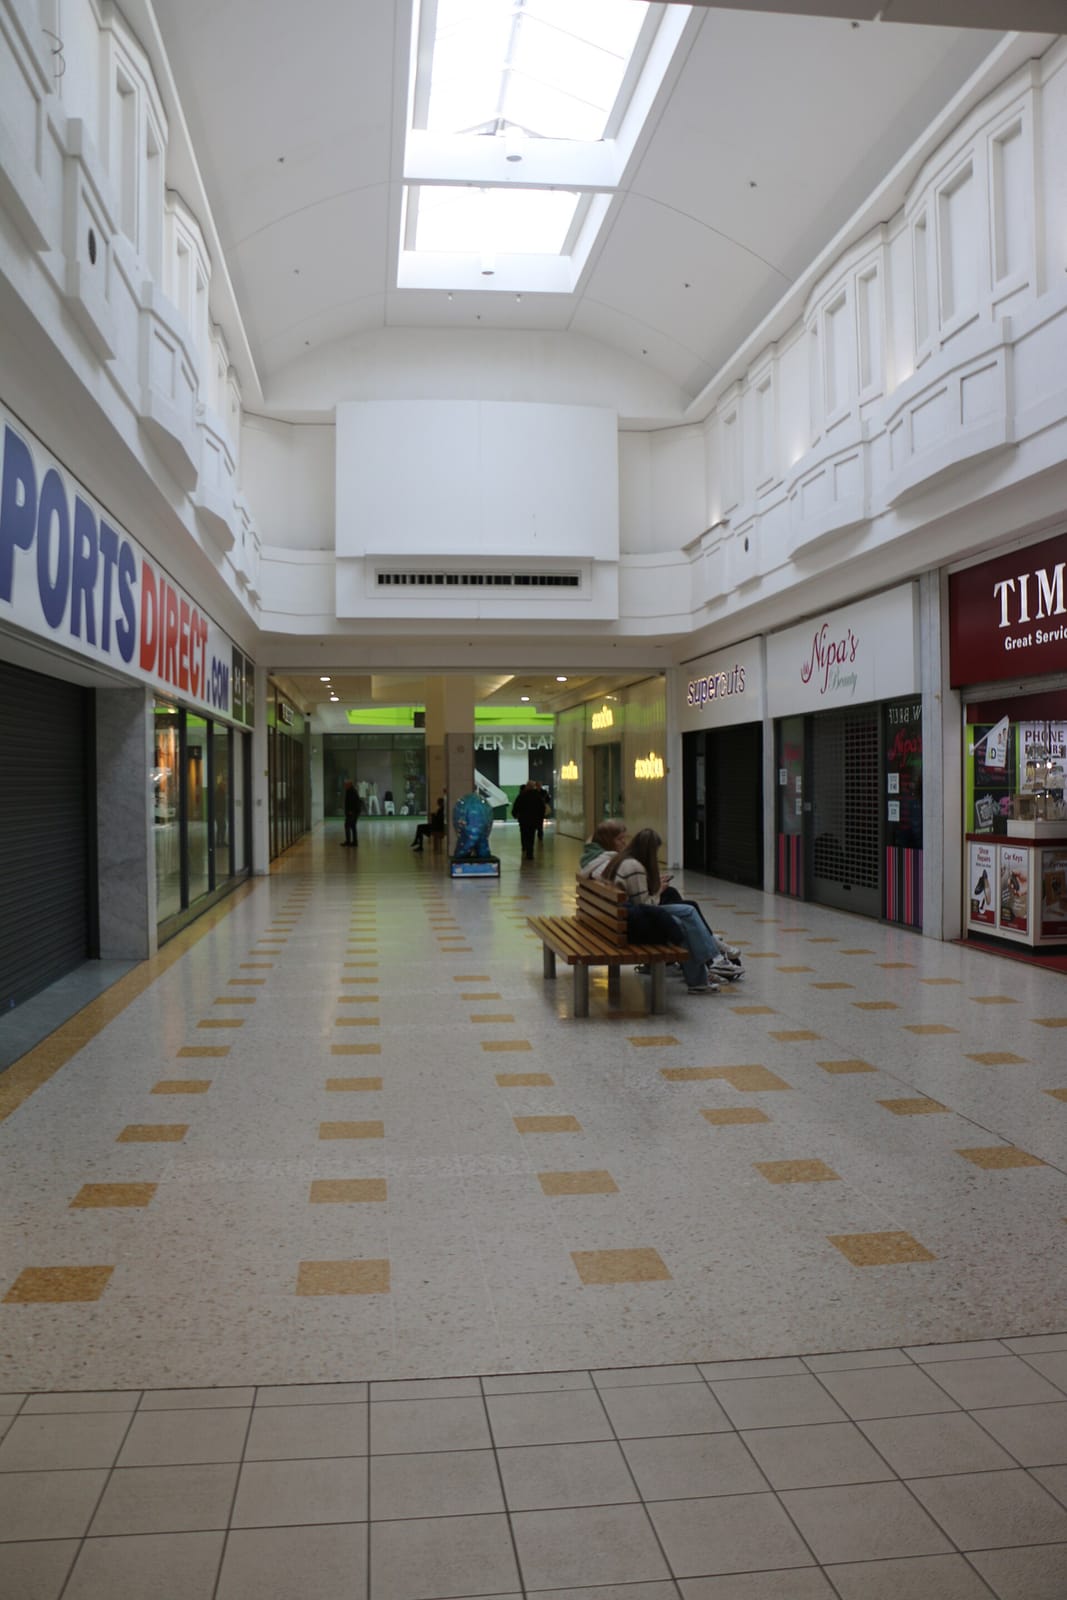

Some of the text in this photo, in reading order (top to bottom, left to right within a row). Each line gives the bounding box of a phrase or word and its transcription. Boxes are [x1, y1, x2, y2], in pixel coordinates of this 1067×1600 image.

[993, 562, 1067, 628] TIM
[801, 623, 859, 694] Nipa's
[1004, 633, 1032, 650] Great
[687, 664, 746, 712] supercuts
[1003, 851, 1023, 864] Car Keys
